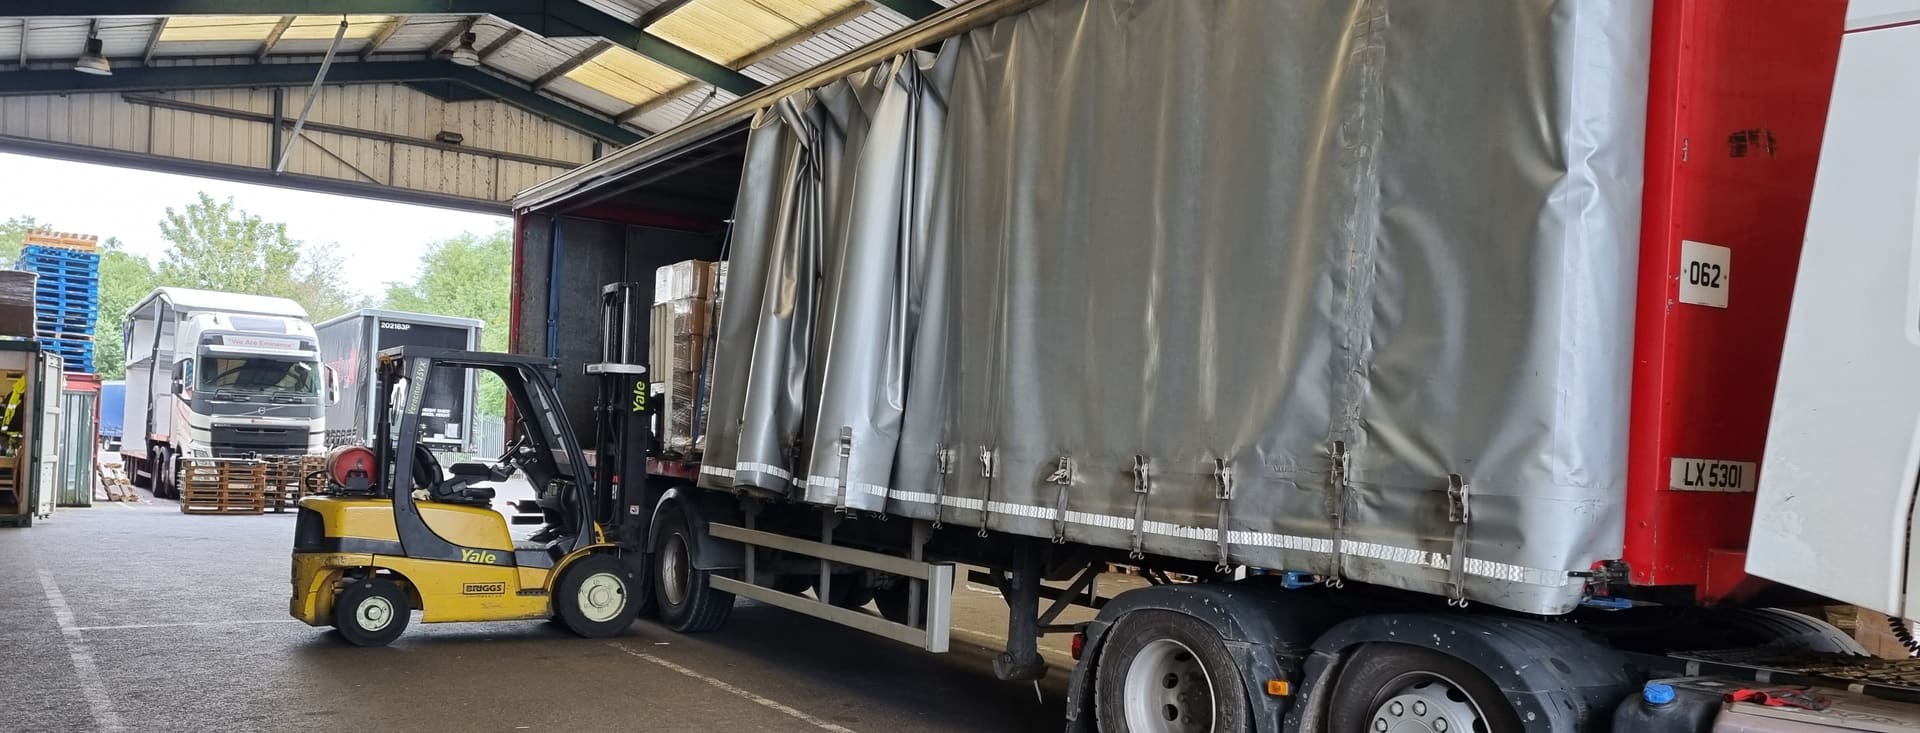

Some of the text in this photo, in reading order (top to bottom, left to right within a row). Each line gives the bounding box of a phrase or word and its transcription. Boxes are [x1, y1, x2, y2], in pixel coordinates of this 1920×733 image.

[1689, 260, 1721, 289] 062
[632, 380, 646, 412] Yale
[1684, 462, 1743, 489] LX 5301
[461, 549, 497, 564] Yale
[465, 583, 503, 593] BRIGGS
